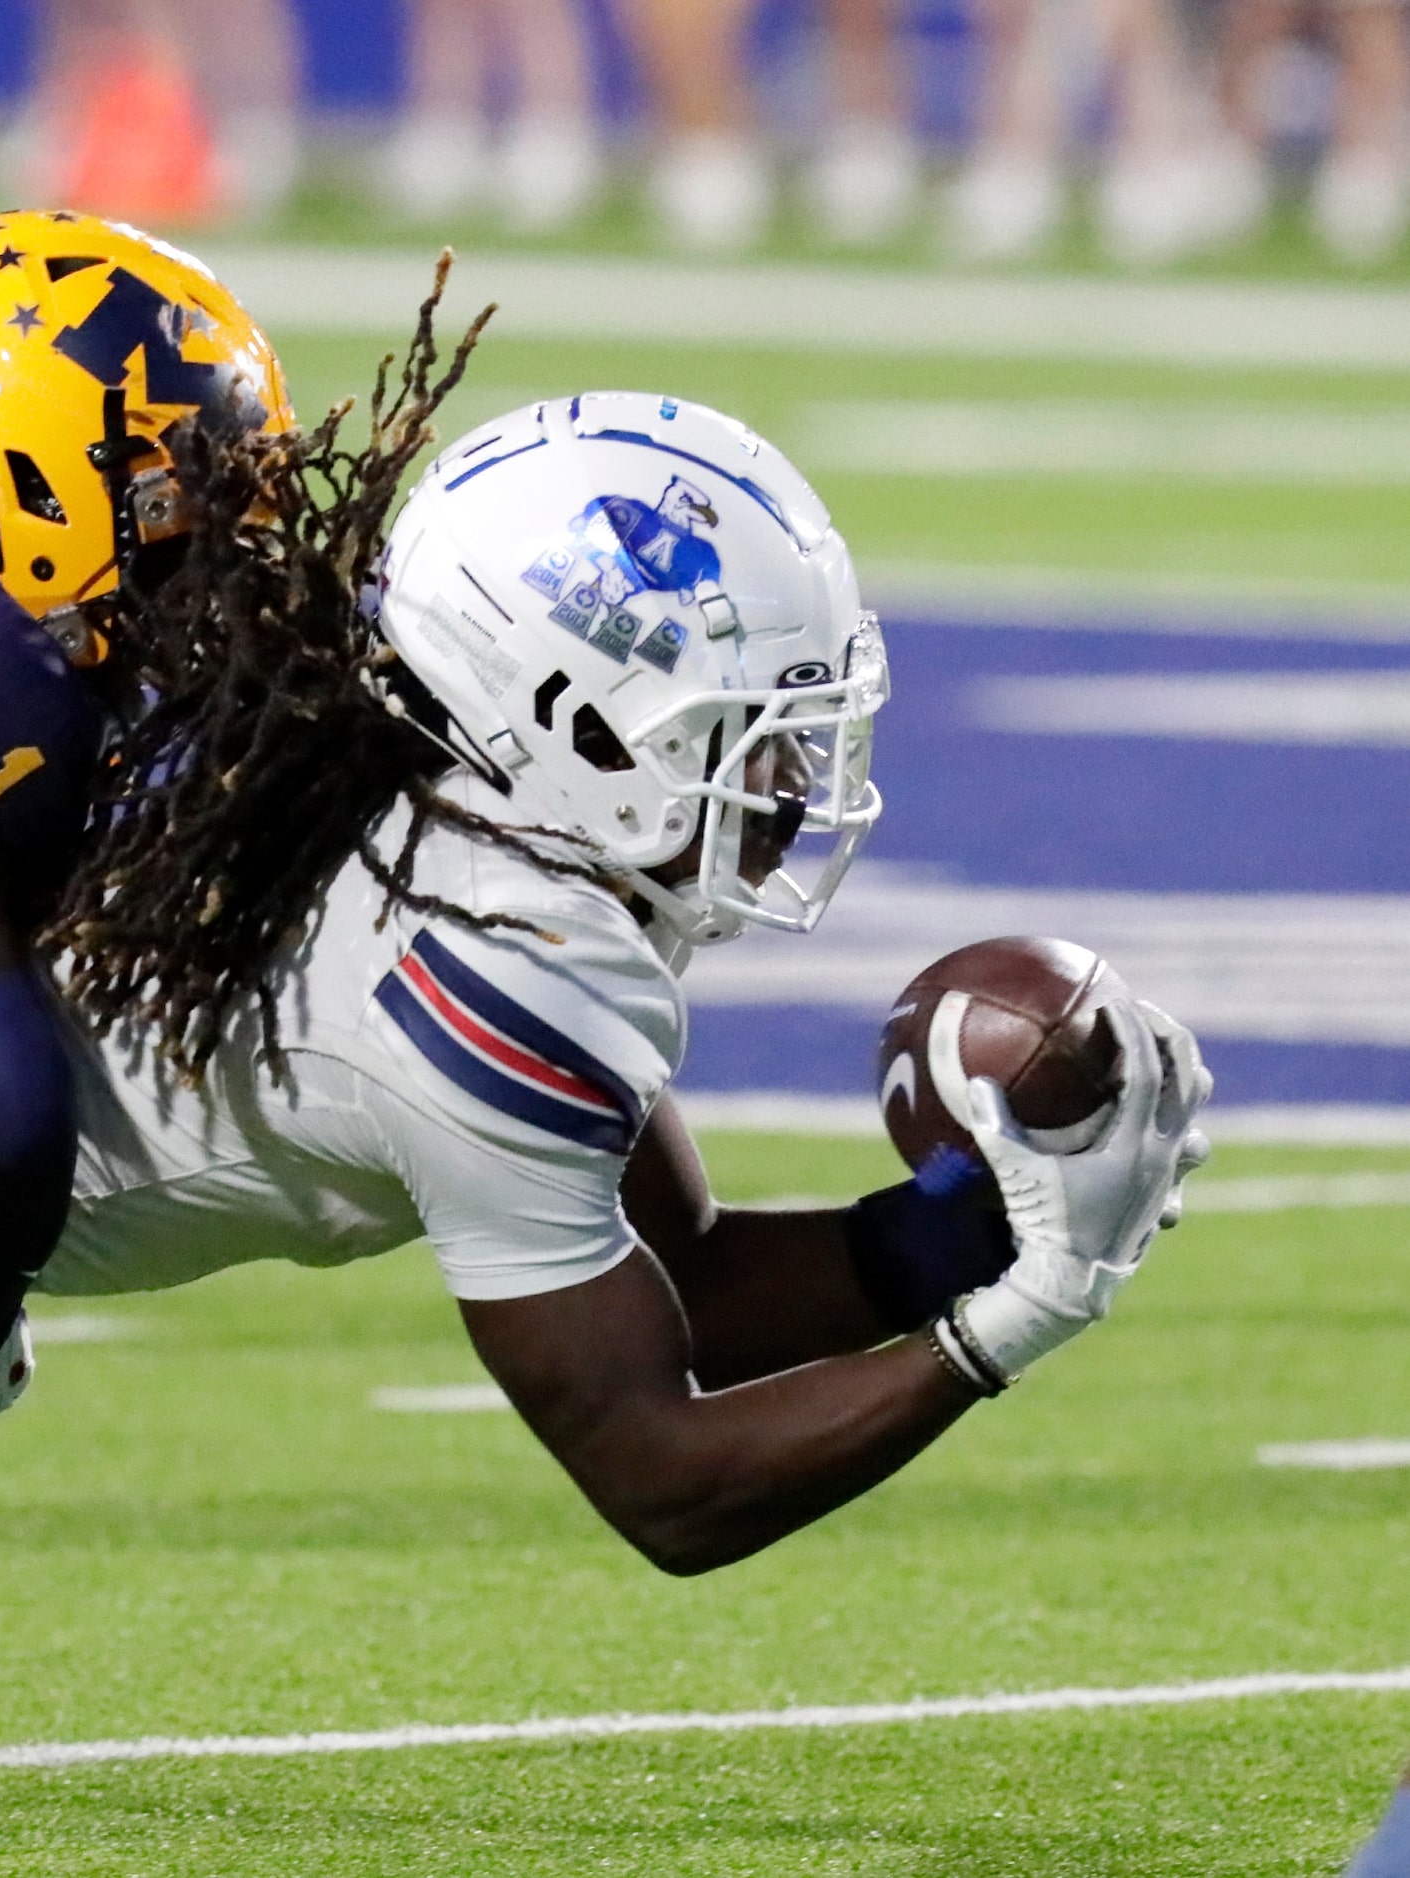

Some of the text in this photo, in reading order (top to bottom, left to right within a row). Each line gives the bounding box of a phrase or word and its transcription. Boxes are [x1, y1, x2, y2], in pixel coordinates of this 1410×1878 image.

[51, 266, 270, 440] M
[637, 529, 681, 573] A
[533, 565, 563, 590] 2014
[557, 602, 590, 629] 2013
